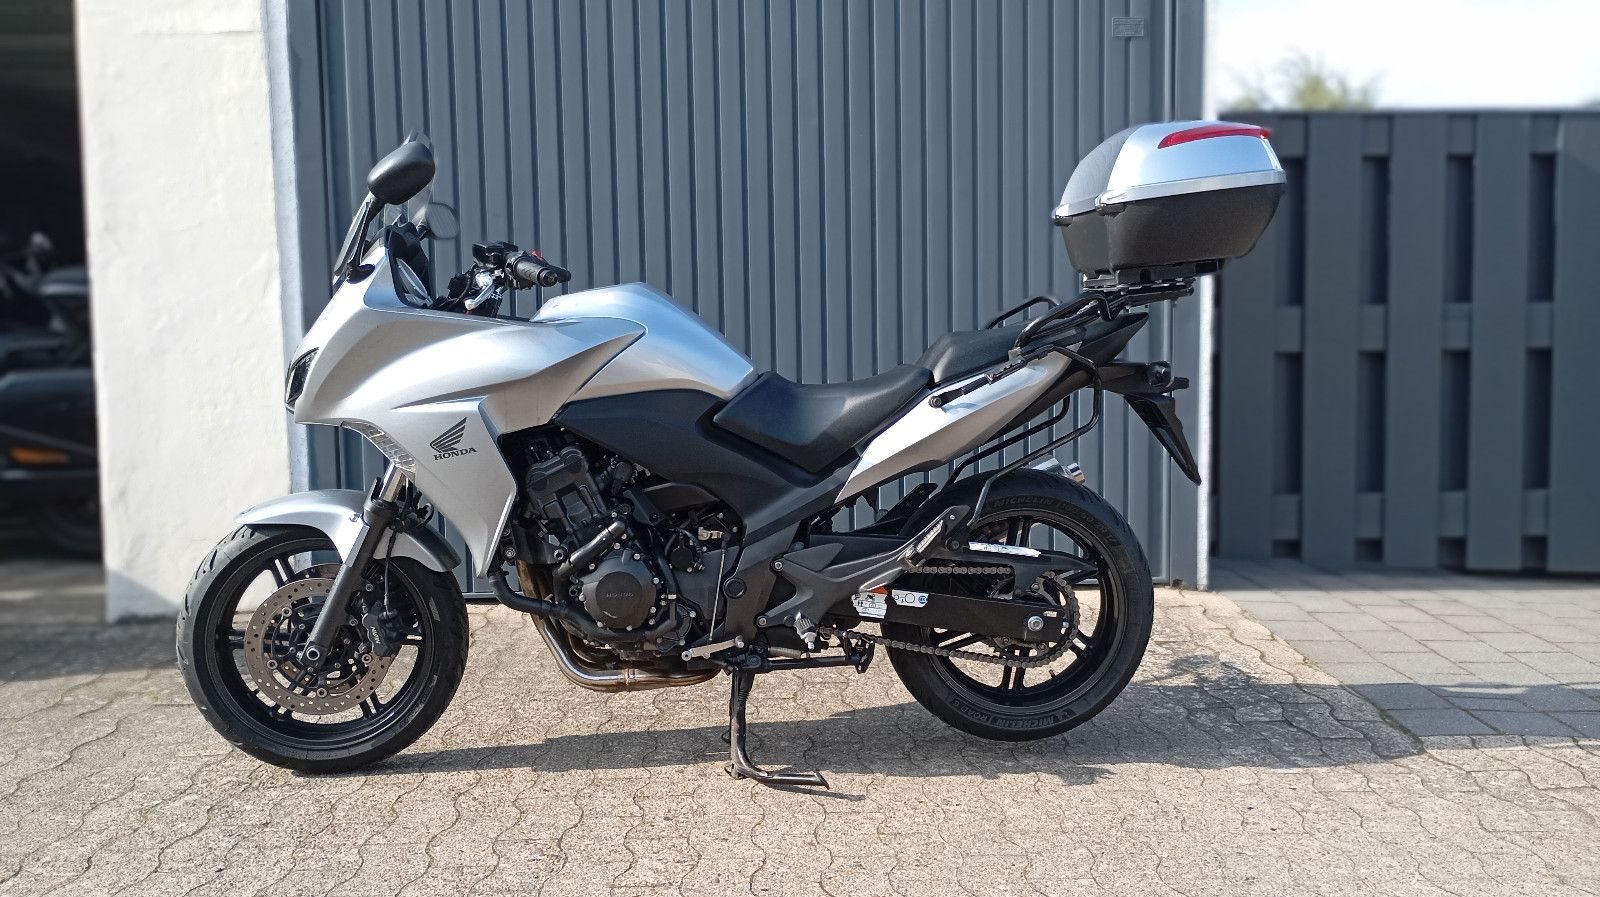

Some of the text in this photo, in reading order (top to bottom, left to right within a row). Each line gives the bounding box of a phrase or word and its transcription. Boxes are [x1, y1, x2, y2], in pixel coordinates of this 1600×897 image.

[433, 447, 478, 461] HONDA
[960, 703, 988, 721] ROAD
[997, 715, 1055, 729] MICHELIN
